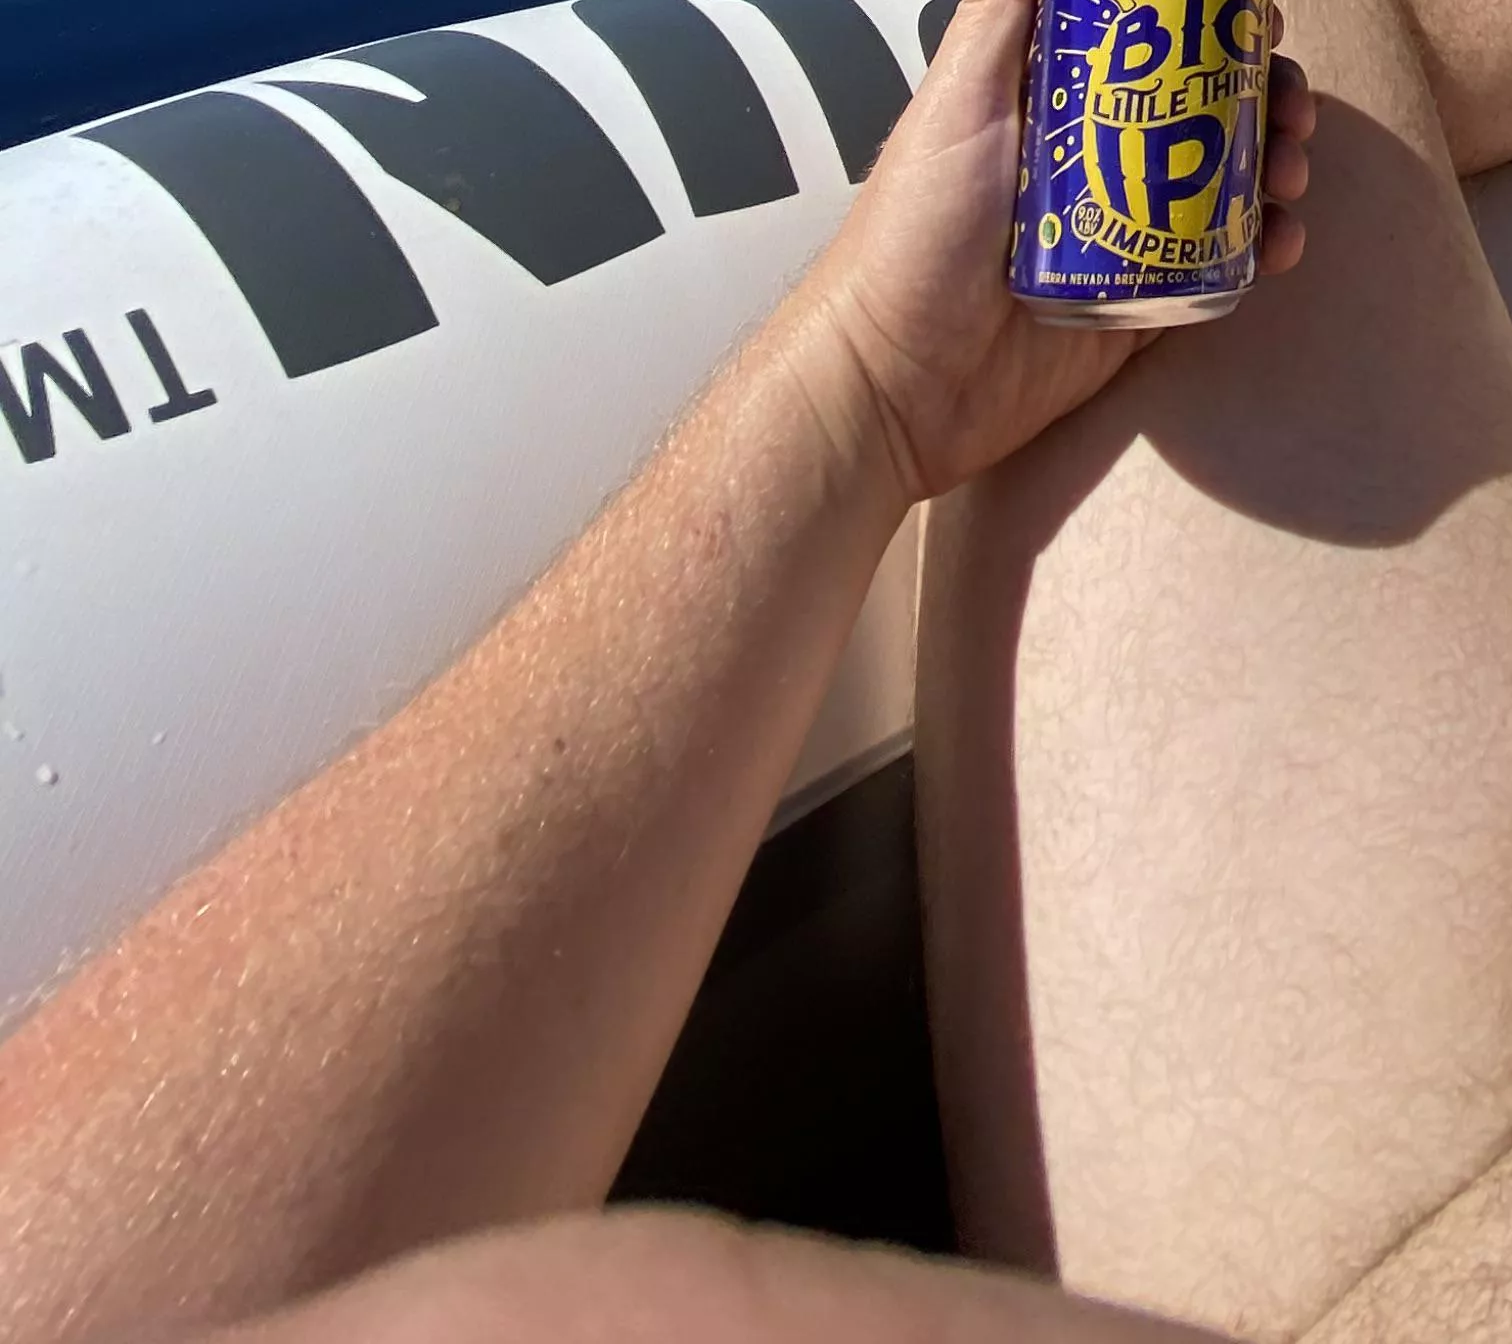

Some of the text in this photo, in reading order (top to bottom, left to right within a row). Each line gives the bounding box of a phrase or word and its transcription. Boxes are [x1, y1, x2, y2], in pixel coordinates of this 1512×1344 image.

[1093, 78, 1189, 123] LITTLE
[1094, 95, 1258, 235] IPA
[1078, 221, 1098, 235] ABV
[1103, 217, 1236, 264] IMPERIAL
[1070, 272, 1110, 285] NEVADA
[1114, 272, 1164, 285] BREWING
